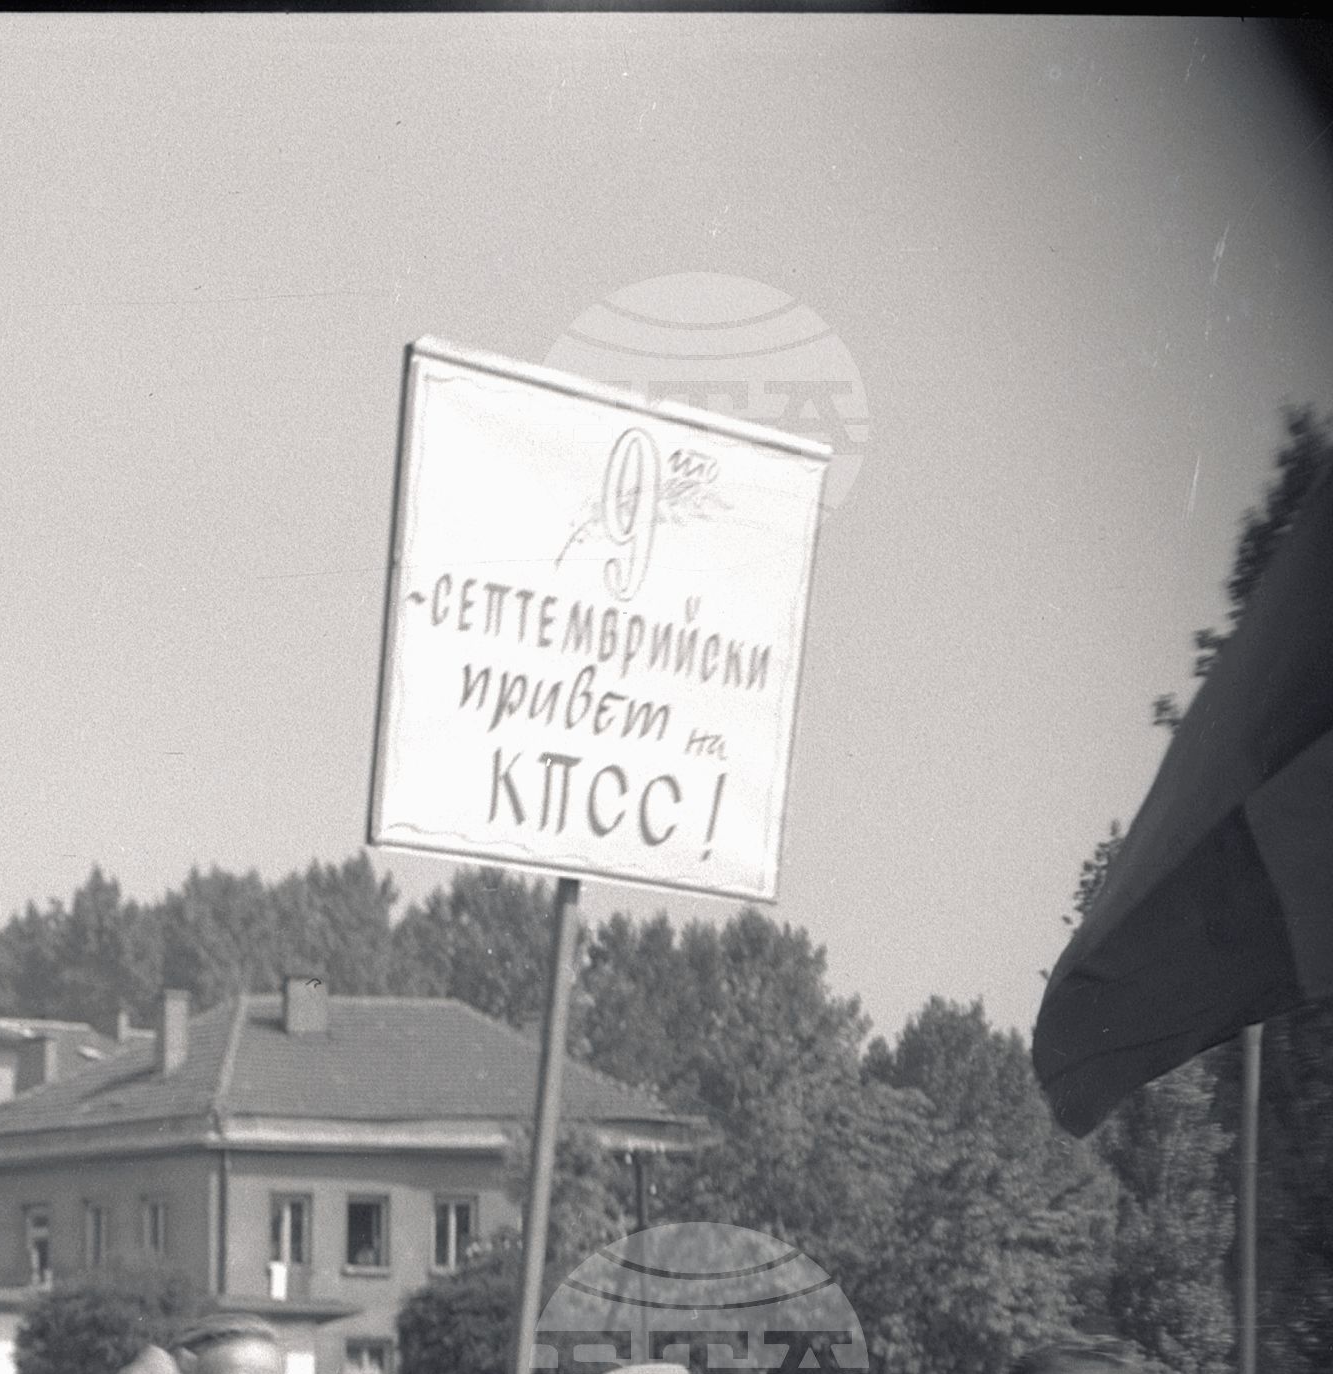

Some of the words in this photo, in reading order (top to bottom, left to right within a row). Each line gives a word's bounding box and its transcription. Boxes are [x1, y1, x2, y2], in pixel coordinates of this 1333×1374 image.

[601, 426, 662, 602] 9
[459, 663, 671, 741] привет
[488, 747, 727, 862] КПСС!
